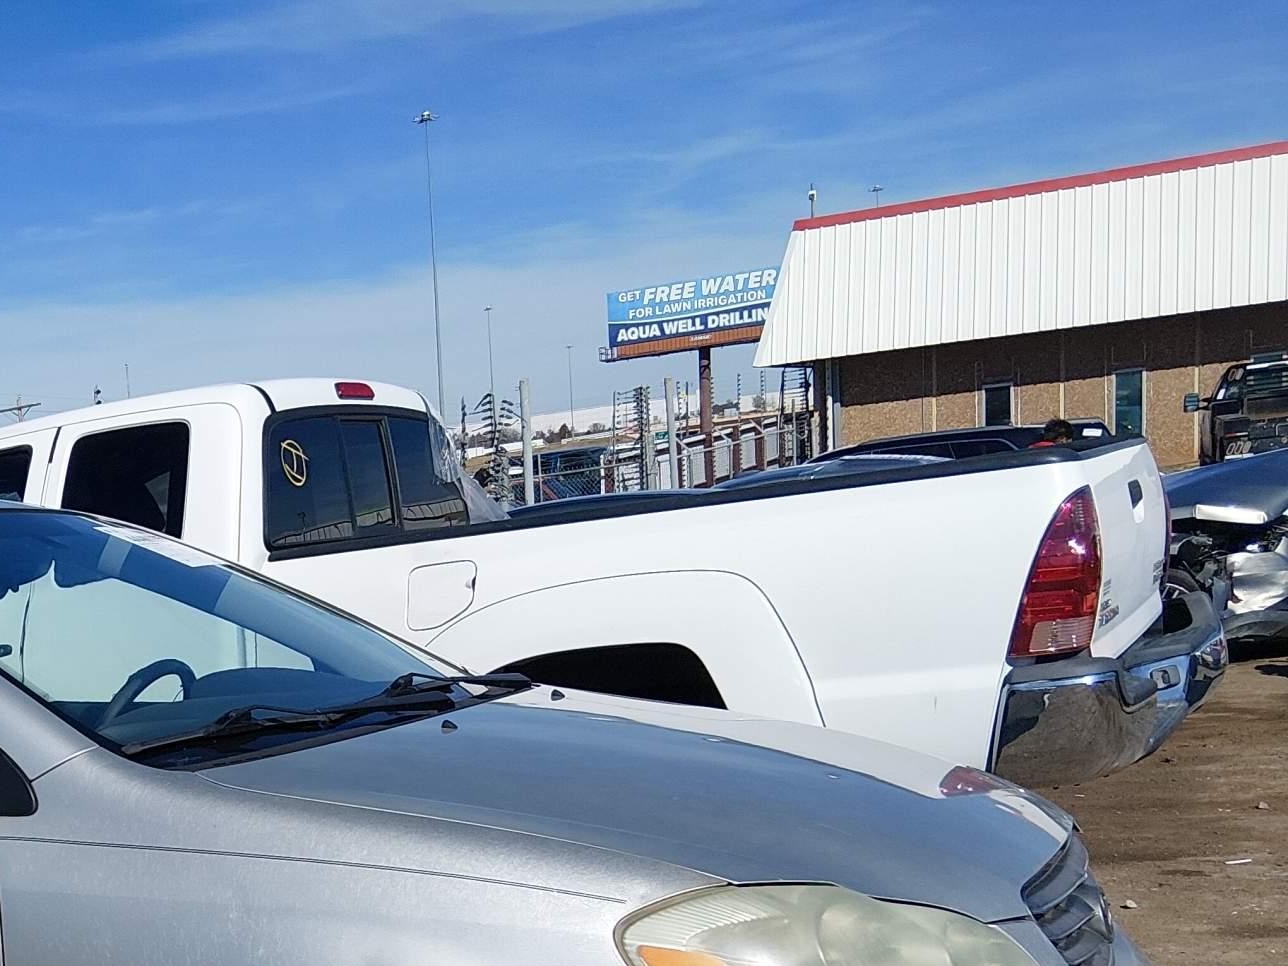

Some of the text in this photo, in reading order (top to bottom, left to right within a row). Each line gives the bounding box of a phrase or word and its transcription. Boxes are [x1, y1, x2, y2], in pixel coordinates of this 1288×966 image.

[618, 269, 777, 304] GET FREE WATER
[629, 290, 766, 320] FOR LAWN IRRIGATION
[617, 308, 769, 342] AQUA WELL DRILLIN
